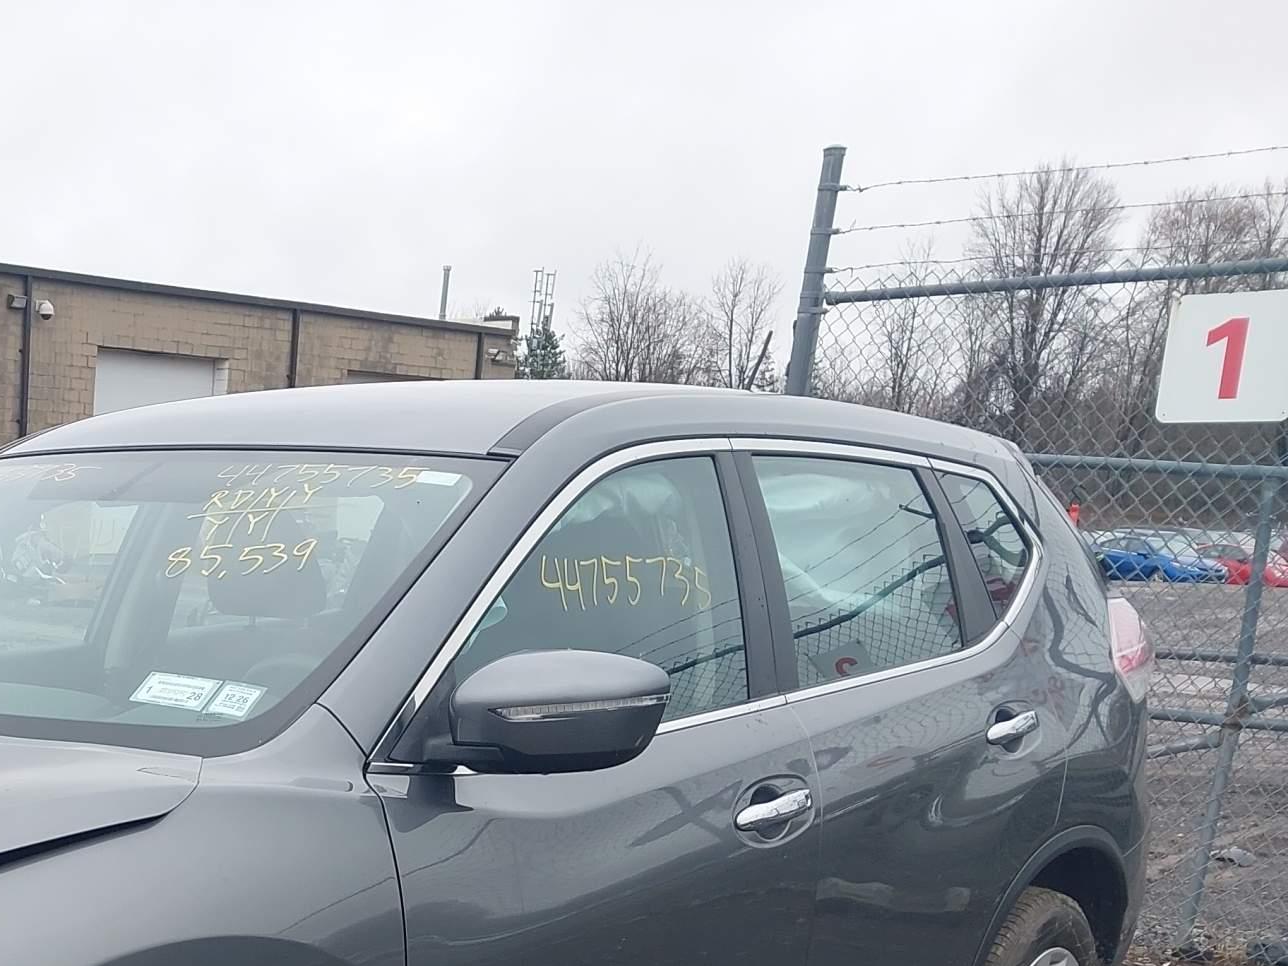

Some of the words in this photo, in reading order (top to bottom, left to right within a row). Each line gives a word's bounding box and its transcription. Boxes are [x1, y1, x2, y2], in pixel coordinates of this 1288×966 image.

[1207, 317, 1250, 399] 1
[217, 464, 430, 489] 44755735
[165, 538, 318, 578] 85,539
[540, 555, 712, 611] 44755735
[186, 692, 203, 701] 28
